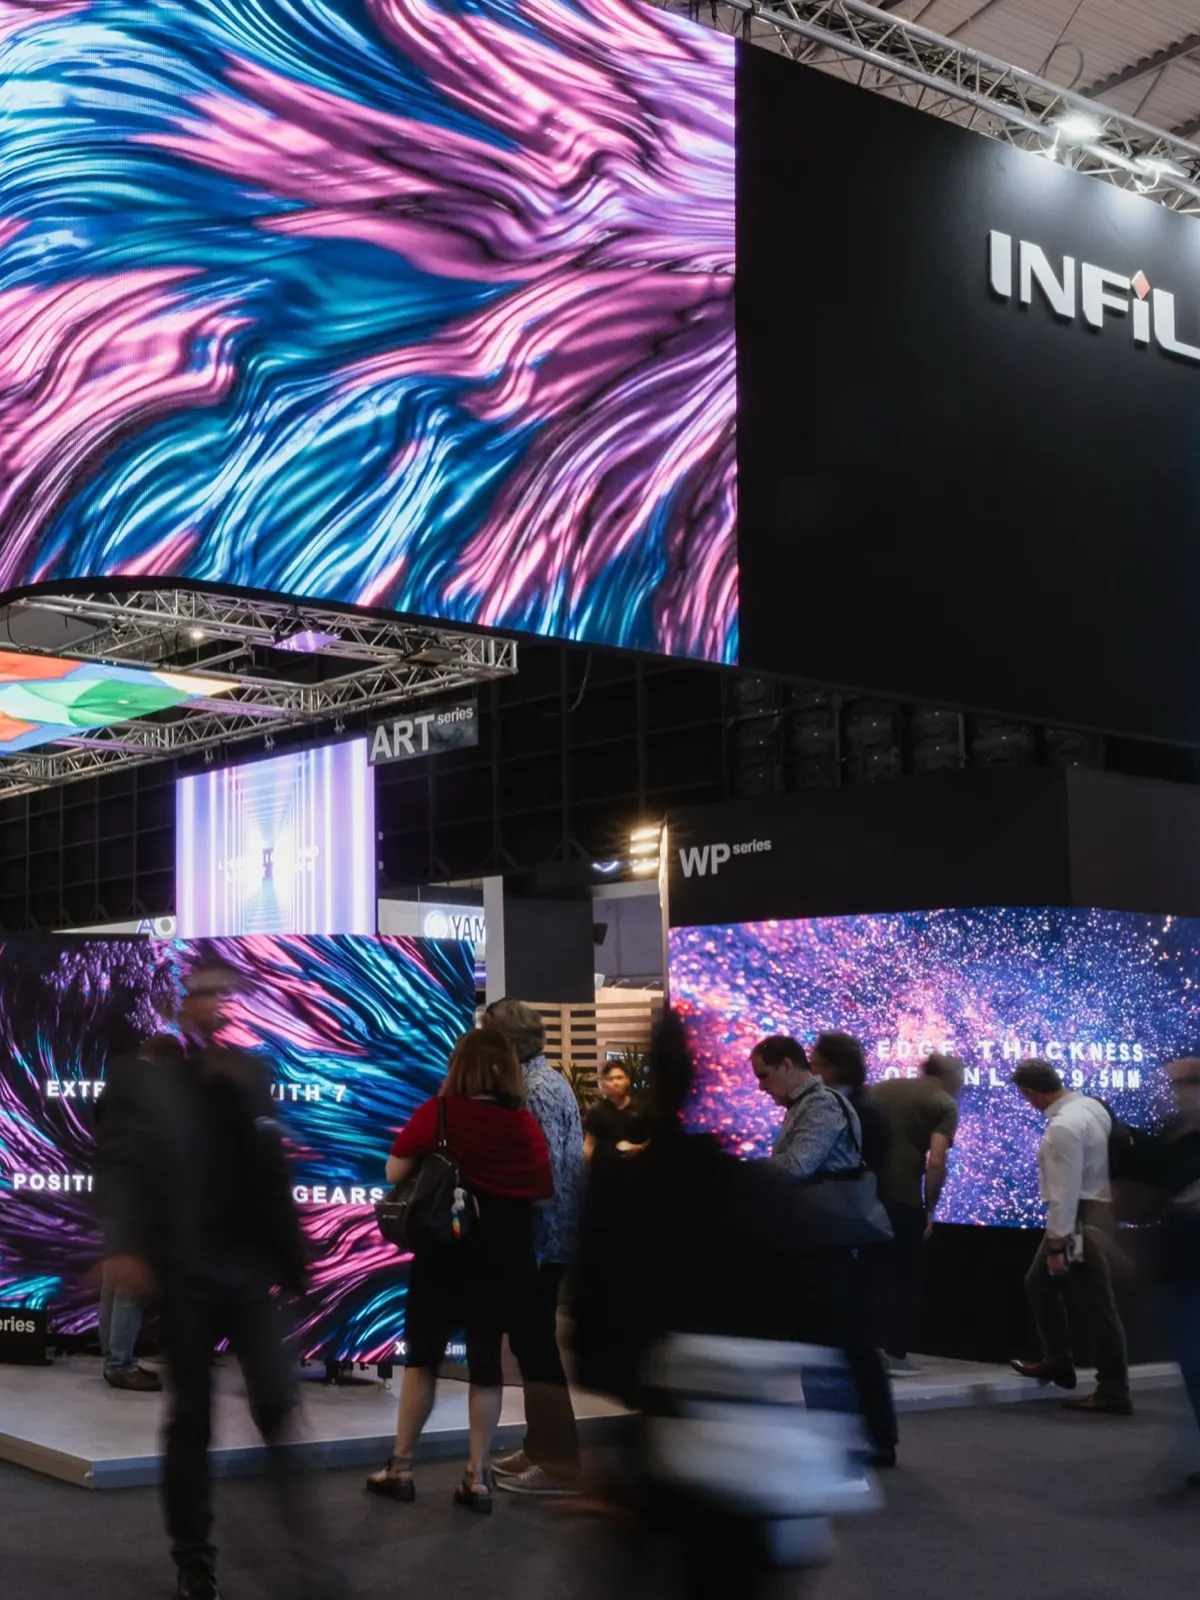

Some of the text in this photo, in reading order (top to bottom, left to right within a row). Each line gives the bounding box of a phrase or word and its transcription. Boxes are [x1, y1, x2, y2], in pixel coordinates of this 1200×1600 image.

[369, 707, 474, 762] ART series
[679, 839, 772, 878] WP series
[979, 1040, 1143, 1062] THICKNESS
[270, 1083, 320, 1102] ITH
[334, 1084, 347, 1102] 7
[292, 1185, 384, 1205] GEARS
